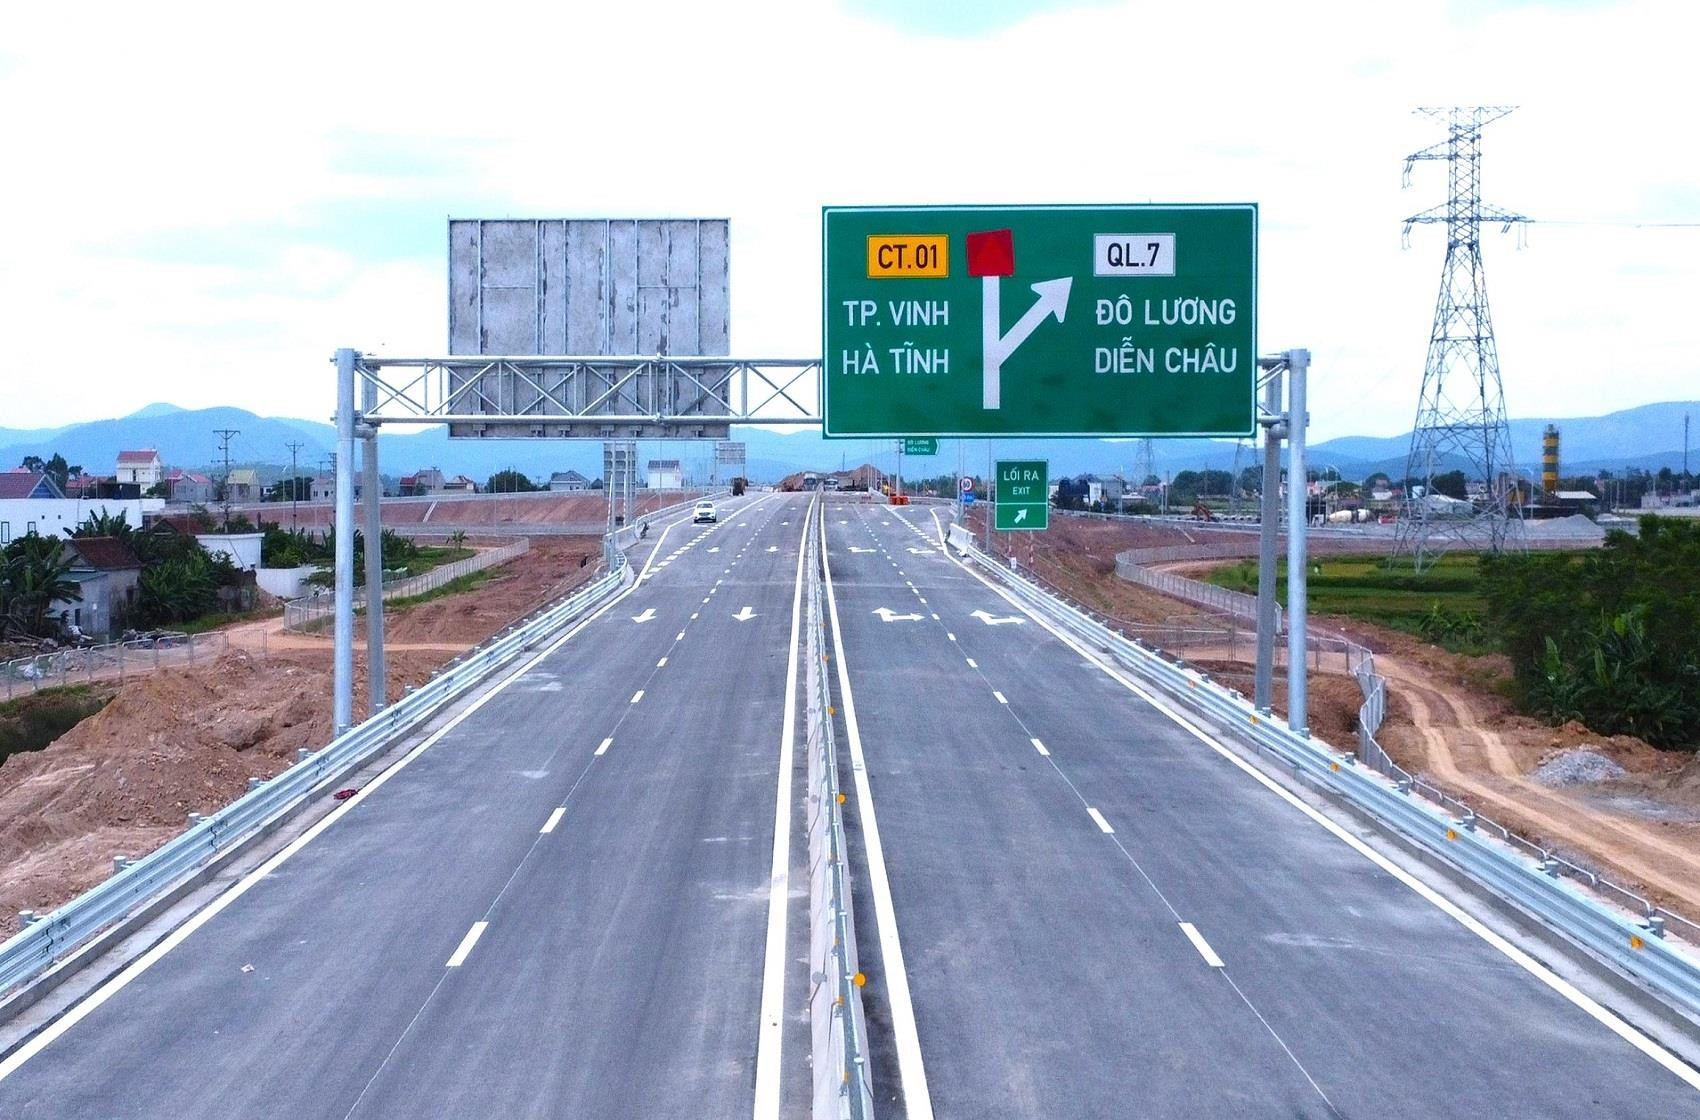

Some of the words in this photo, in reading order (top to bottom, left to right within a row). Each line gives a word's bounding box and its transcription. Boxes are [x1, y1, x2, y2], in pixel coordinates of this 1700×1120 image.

[878, 244, 937, 269] CT.01
[1107, 243, 1160, 268] QL.7
[843, 300, 880, 326] TP.
[889, 300, 949, 326] VINH
[1096, 294, 1132, 326] ĐÔ
[1144, 296, 1236, 326] LƯƠNG
[842, 343, 880, 374] HÀ
[889, 341, 949, 374] TĨNH
[1095, 336, 1155, 373] DIỄN
[1164, 342, 1237, 373] CHÂU
[1003, 466, 1020, 481] LỐI
[1023, 470, 1039, 481] RA
[1012, 486, 1031, 495] EXIT
